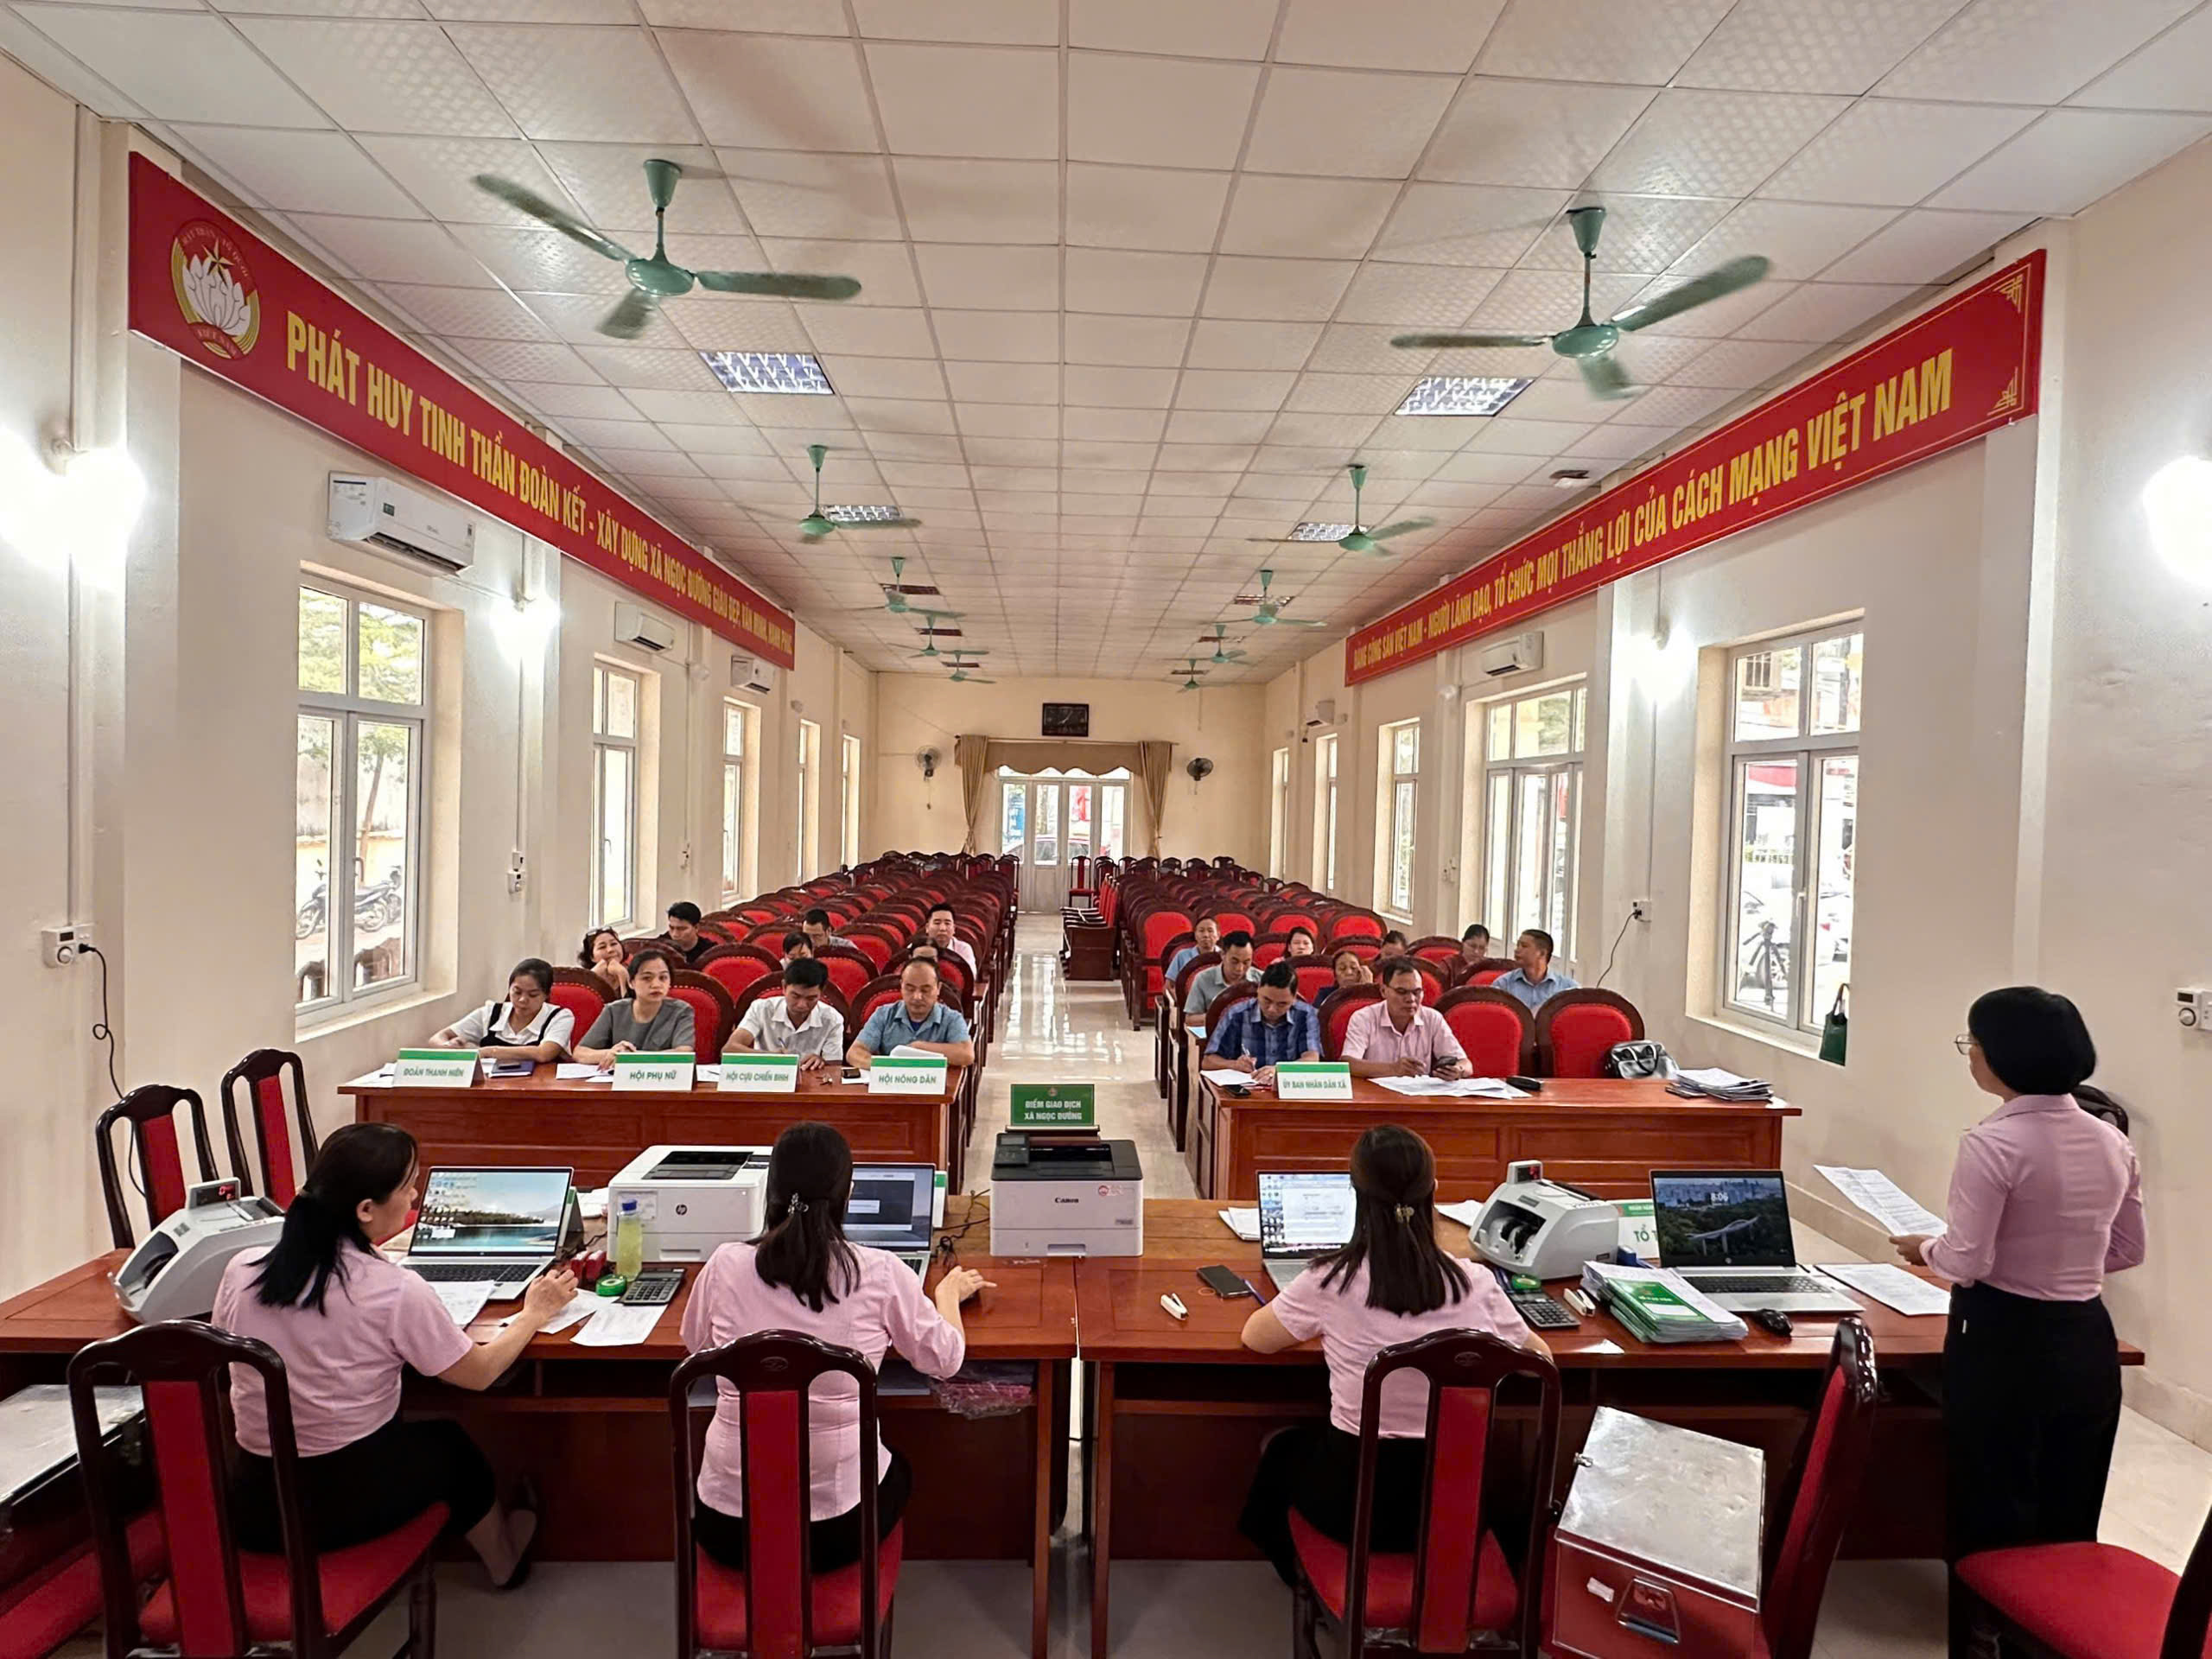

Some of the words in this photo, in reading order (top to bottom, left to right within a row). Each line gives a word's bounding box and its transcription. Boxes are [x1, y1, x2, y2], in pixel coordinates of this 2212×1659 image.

[287, 310, 360, 406] PHÁT
[366, 362, 414, 435] HUY
[419, 395, 466, 467] TINH
[470, 430, 516, 497] THẦN
[519, 460, 560, 522] ĐOÀN
[563, 485, 587, 537] KẾT
[596, 508, 620, 556] XÂY
[620, 525, 649, 572] DỰNG
[650, 543, 664, 581] XÃ
[664, 552, 686, 598] NGỌC
[1451, 593, 1472, 626] LÃNH
[1494, 561, 1506, 609] TỔ
[1507, 558, 1534, 603] CHỨC
[1536, 550, 1559, 594] MỌI
[1561, 521, 1604, 580] THẮNG
[1606, 509, 1630, 563] LỢI
[1633, 485, 1667, 547] CỦA
[1672, 469, 1724, 530] CÁCH
[1728, 428, 1799, 505] MẠNG
[1807, 391, 1866, 471] VIỆT
[1872, 348, 1953, 442] NAM
[630, 1070, 645, 1081] HỘI
[647, 1071, 663, 1082] PHỤ
[664, 1071, 677, 1080] NỮ
[879, 1072, 893, 1084] HỘI
[894, 1073, 918, 1084] NÔNG
[919, 1074, 937, 1084] DÂN
[1025, 1097, 1044, 1108] ĐIỂM
[1064, 1100, 1082, 1109] DỊCH
[1035, 1112, 1056, 1122] NGỌC
[1633, 1224, 1649, 1243] TỔ
